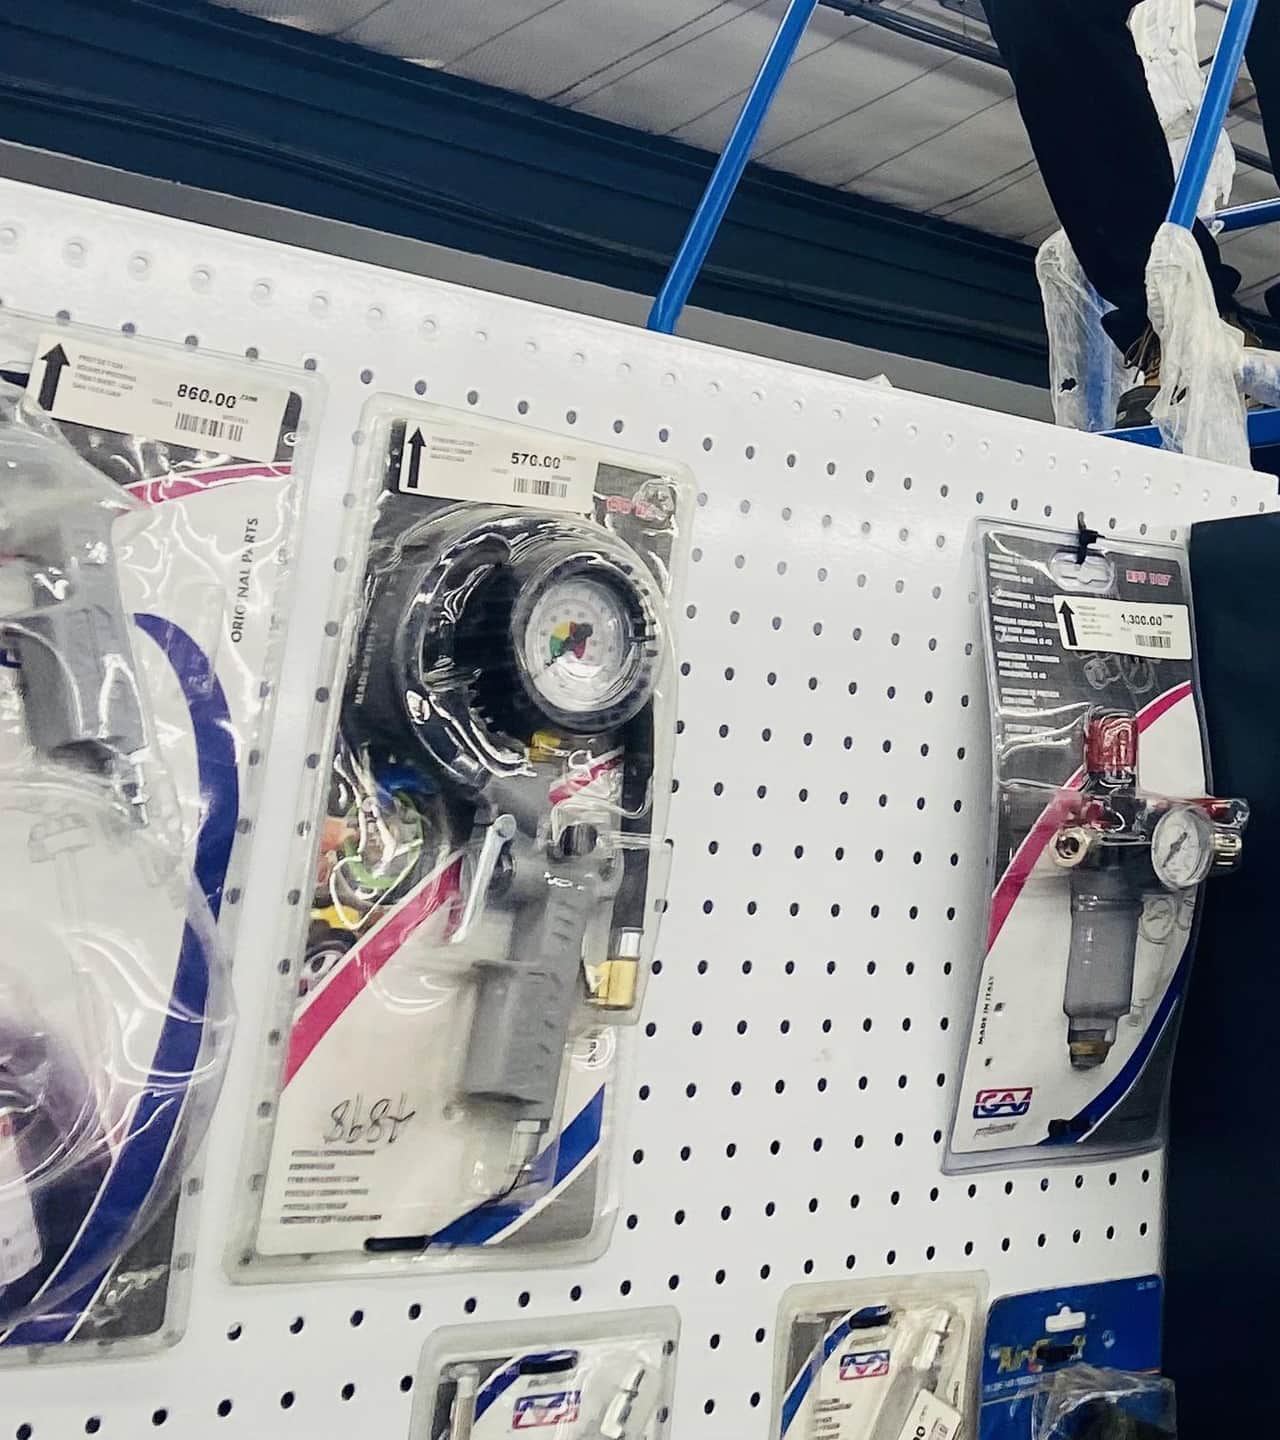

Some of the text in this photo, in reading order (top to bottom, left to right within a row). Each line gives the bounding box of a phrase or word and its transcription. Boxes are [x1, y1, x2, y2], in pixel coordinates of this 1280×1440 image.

[177, 383, 237, 409] 860.00
[510, 451, 561, 470] 570.00
[230, 567, 251, 643] ORIGNAL
[977, 975, 994, 1045] MADE IN ITALY
